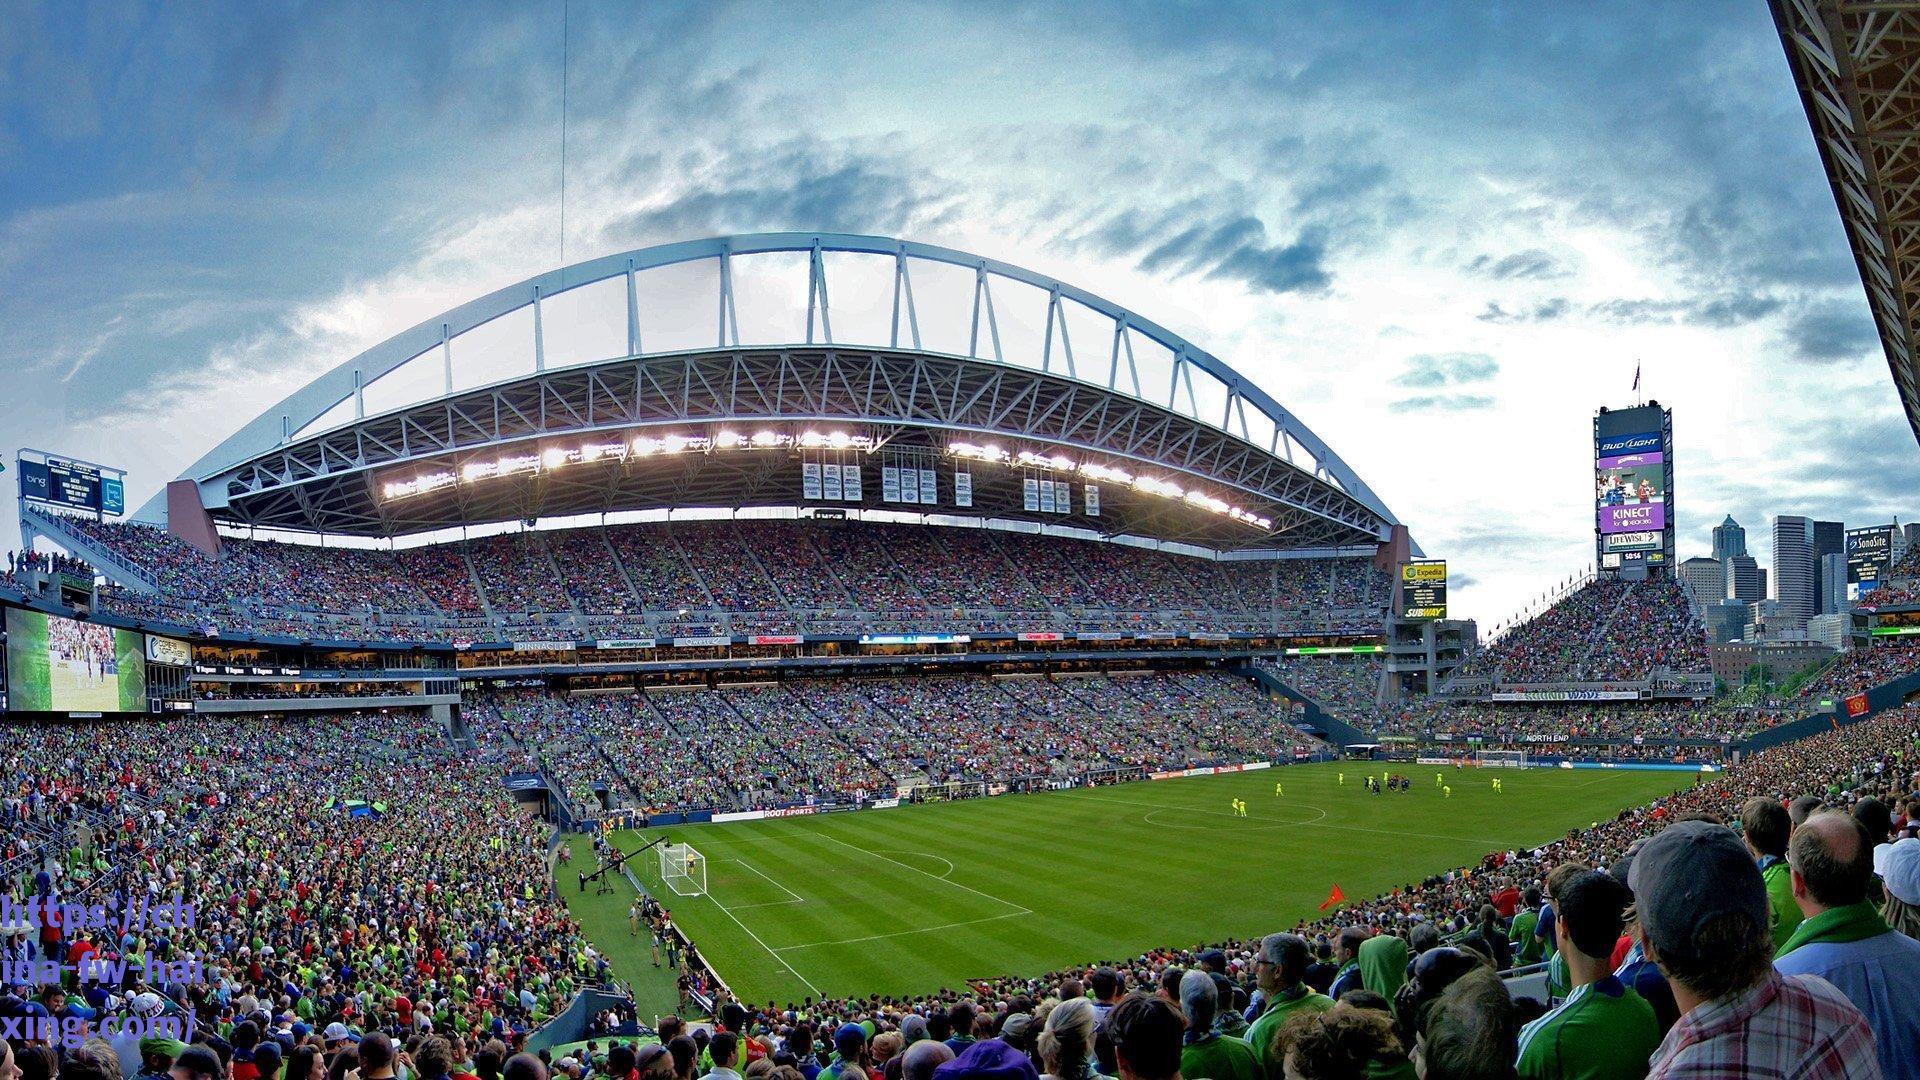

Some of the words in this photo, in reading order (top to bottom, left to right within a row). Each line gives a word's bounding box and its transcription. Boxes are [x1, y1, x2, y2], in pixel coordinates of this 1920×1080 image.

[1628, 438, 1659, 448] LIGHT
[26, 474, 46, 488] bing
[1613, 507, 1653, 519] KINECT
[1857, 535, 1886, 549] SonoSite
[1416, 568, 1443, 577] Expedia
[1405, 608, 1445, 618] SUBWAY
[685, 637, 710, 646] Qwest
[1526, 735, 1552, 743] NORTH
[765, 808, 786, 818] ROOT
[786, 806, 814, 817] SPORTS
